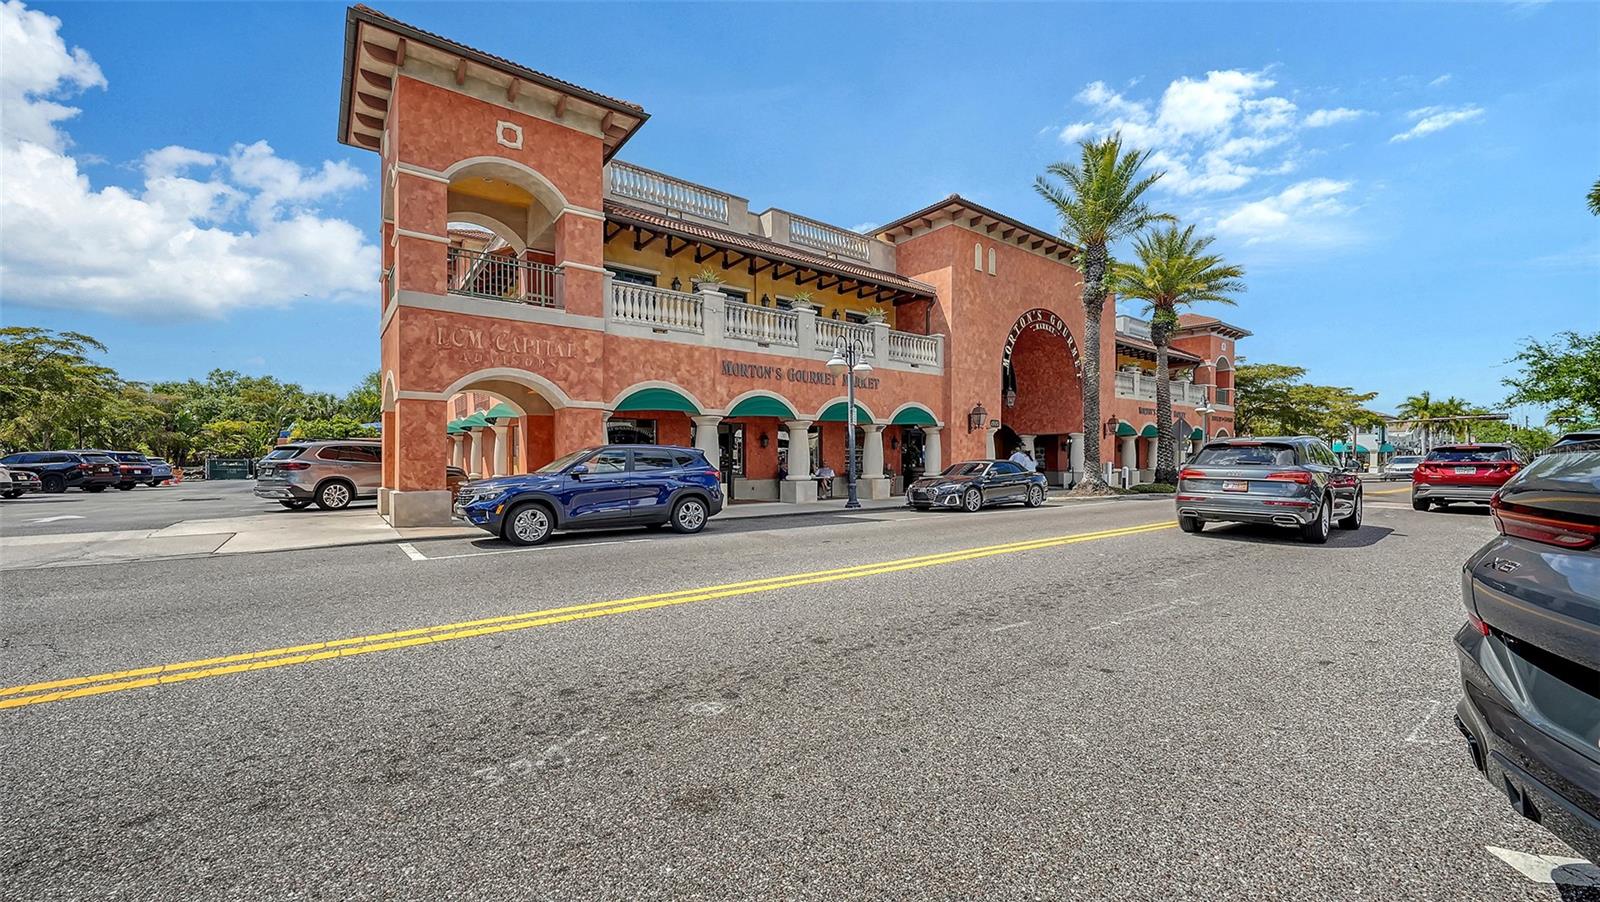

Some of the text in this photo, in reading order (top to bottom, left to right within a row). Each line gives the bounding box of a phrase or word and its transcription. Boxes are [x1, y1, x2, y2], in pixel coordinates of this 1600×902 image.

[436, 327, 578, 359] LCM CAPITAL
[1002, 310, 1043, 369] MORTON'S
[721, 360, 782, 381] MORTON'S
[787, 368, 836, 386] GOURMET
